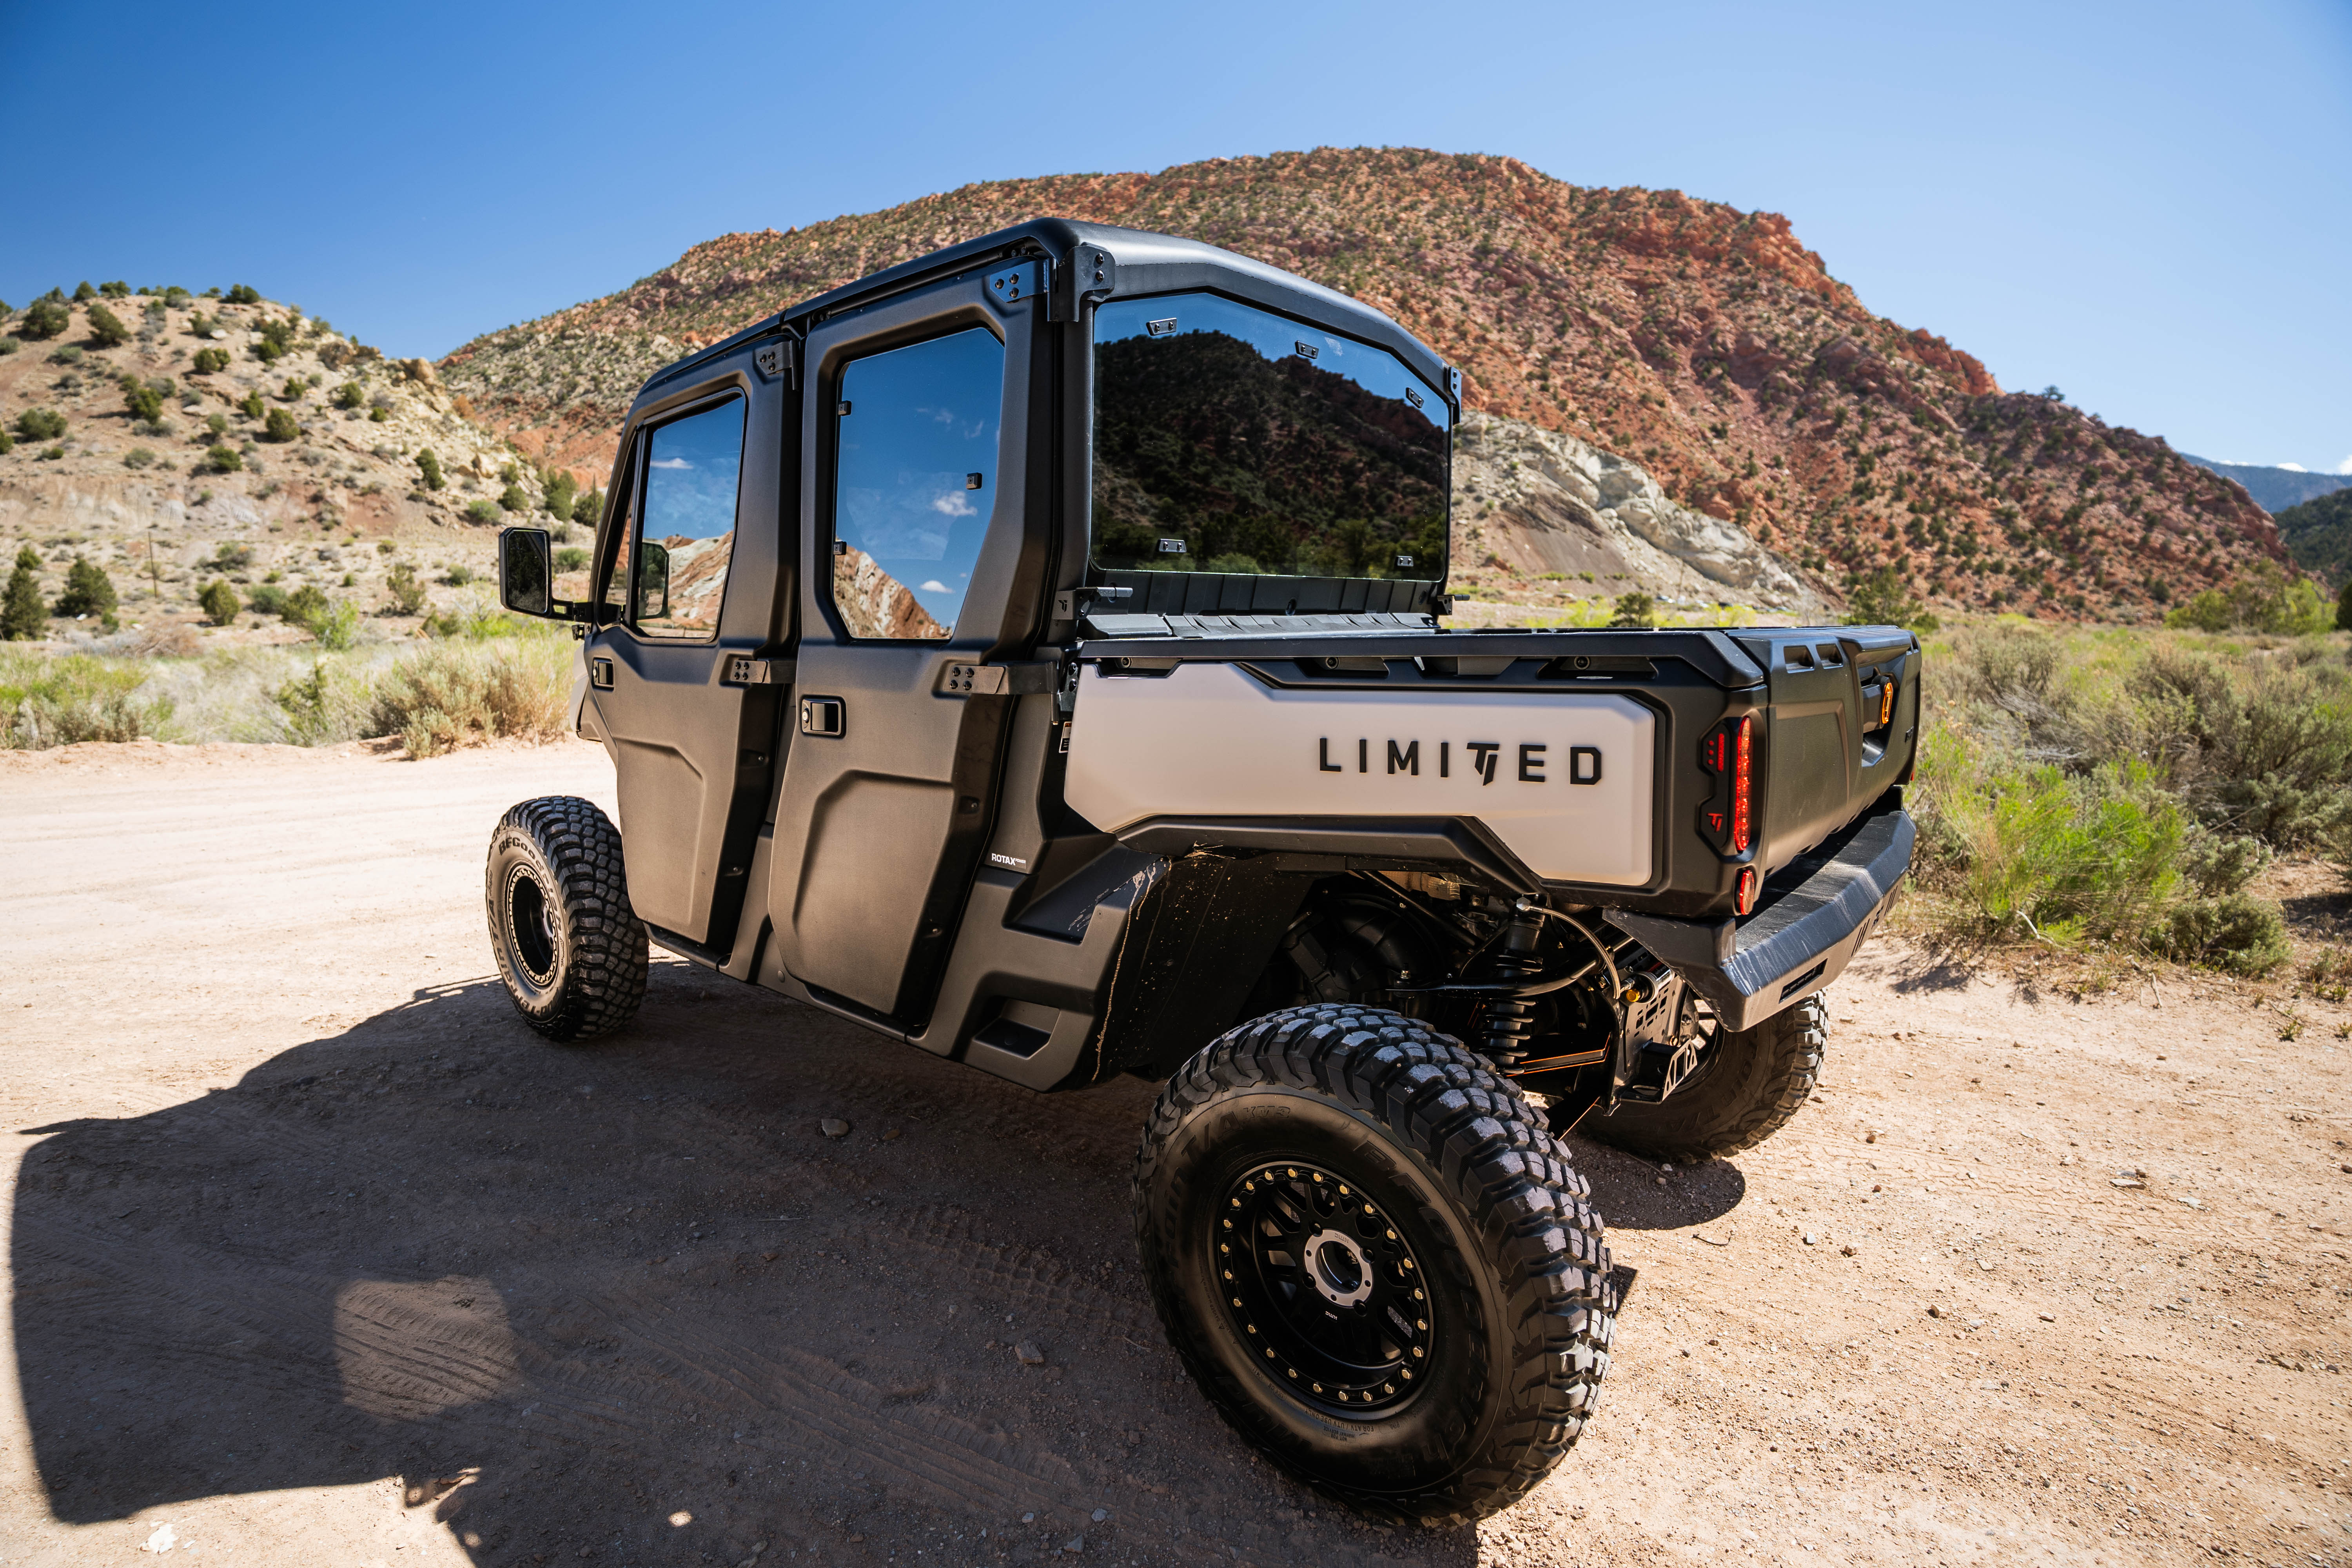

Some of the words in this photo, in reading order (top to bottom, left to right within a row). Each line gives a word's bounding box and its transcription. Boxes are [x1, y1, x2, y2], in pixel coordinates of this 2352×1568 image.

[1319, 738, 1602, 786] LIMITED
[991, 853, 1016, 866] ROTAX
[498, 837, 562, 931] BFGoodrich
[1181, 1111, 1243, 1166] T/A
[1243, 1105, 1291, 1119] KM3
[1325, 1311, 1338, 1320] kmc
[1352, 1140, 1490, 1463] BFGoodrich
[1304, 1408, 1319, 1420] ONLY
[1320, 1416, 1332, 1424] USE
